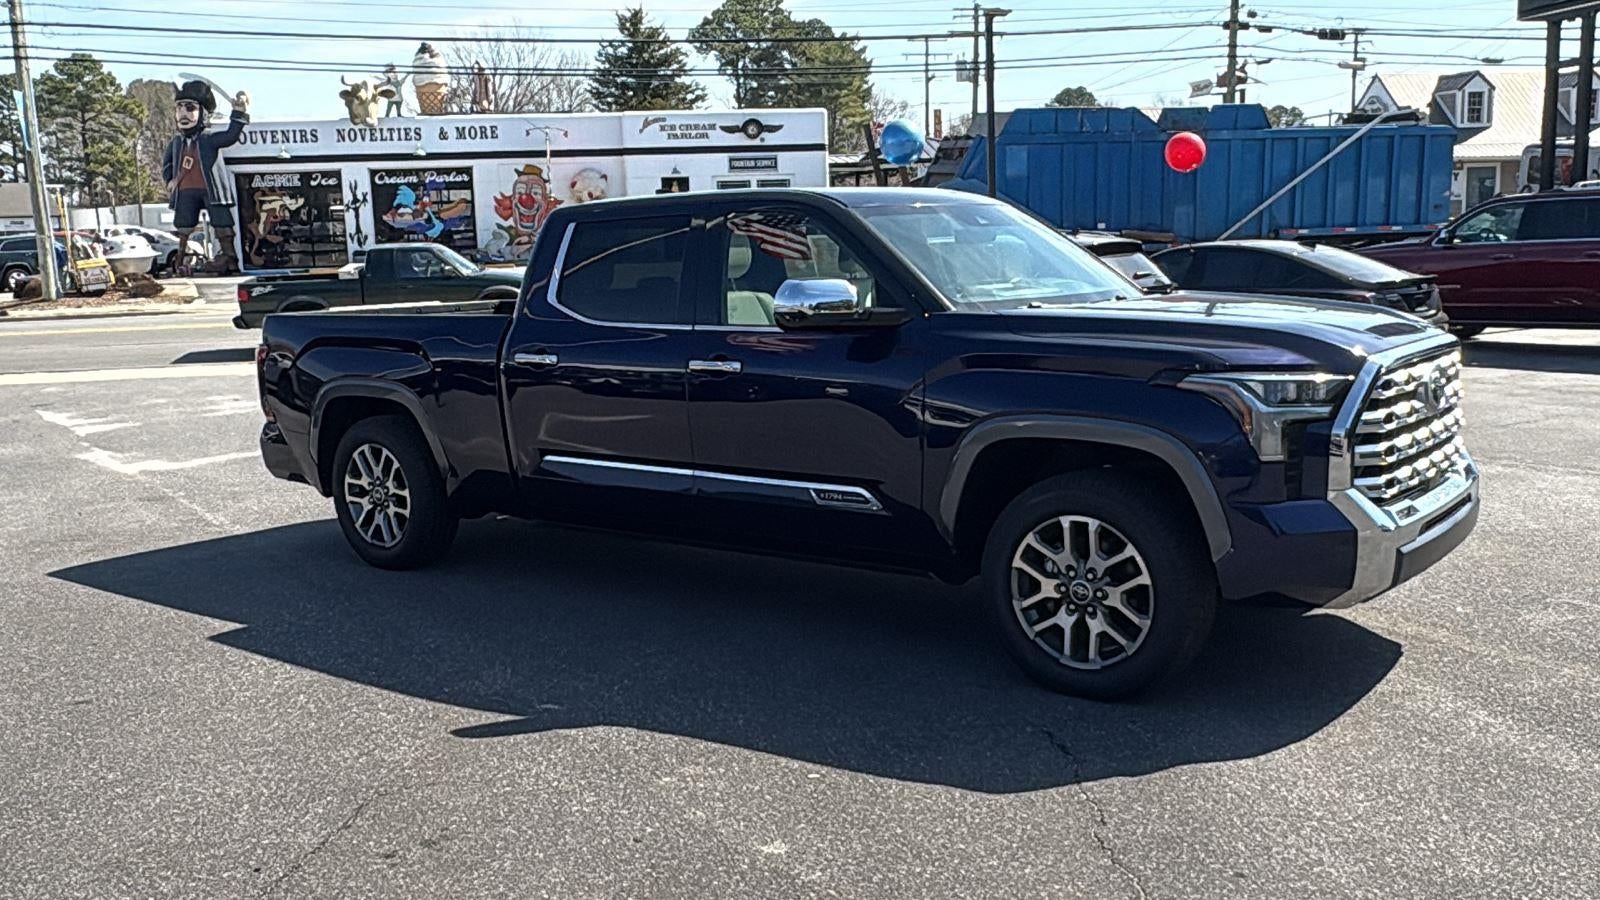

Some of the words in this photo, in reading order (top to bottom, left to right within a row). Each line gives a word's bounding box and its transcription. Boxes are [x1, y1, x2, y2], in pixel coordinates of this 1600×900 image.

[238, 128, 319, 145] OUVENIRS
[335, 126, 423, 143] NOVELTIES
[438, 126, 449, 141] &
[454, 125, 499, 140] MORE
[659, 123, 677, 132] ICE
[678, 123, 717, 131] CREAM
[667, 132, 710, 140] PARLOR
[251, 173, 302, 188] ACME
[309, 172, 339, 187] Ice
[374, 171, 419, 185] Cream
[424, 170, 471, 183] Parlor
